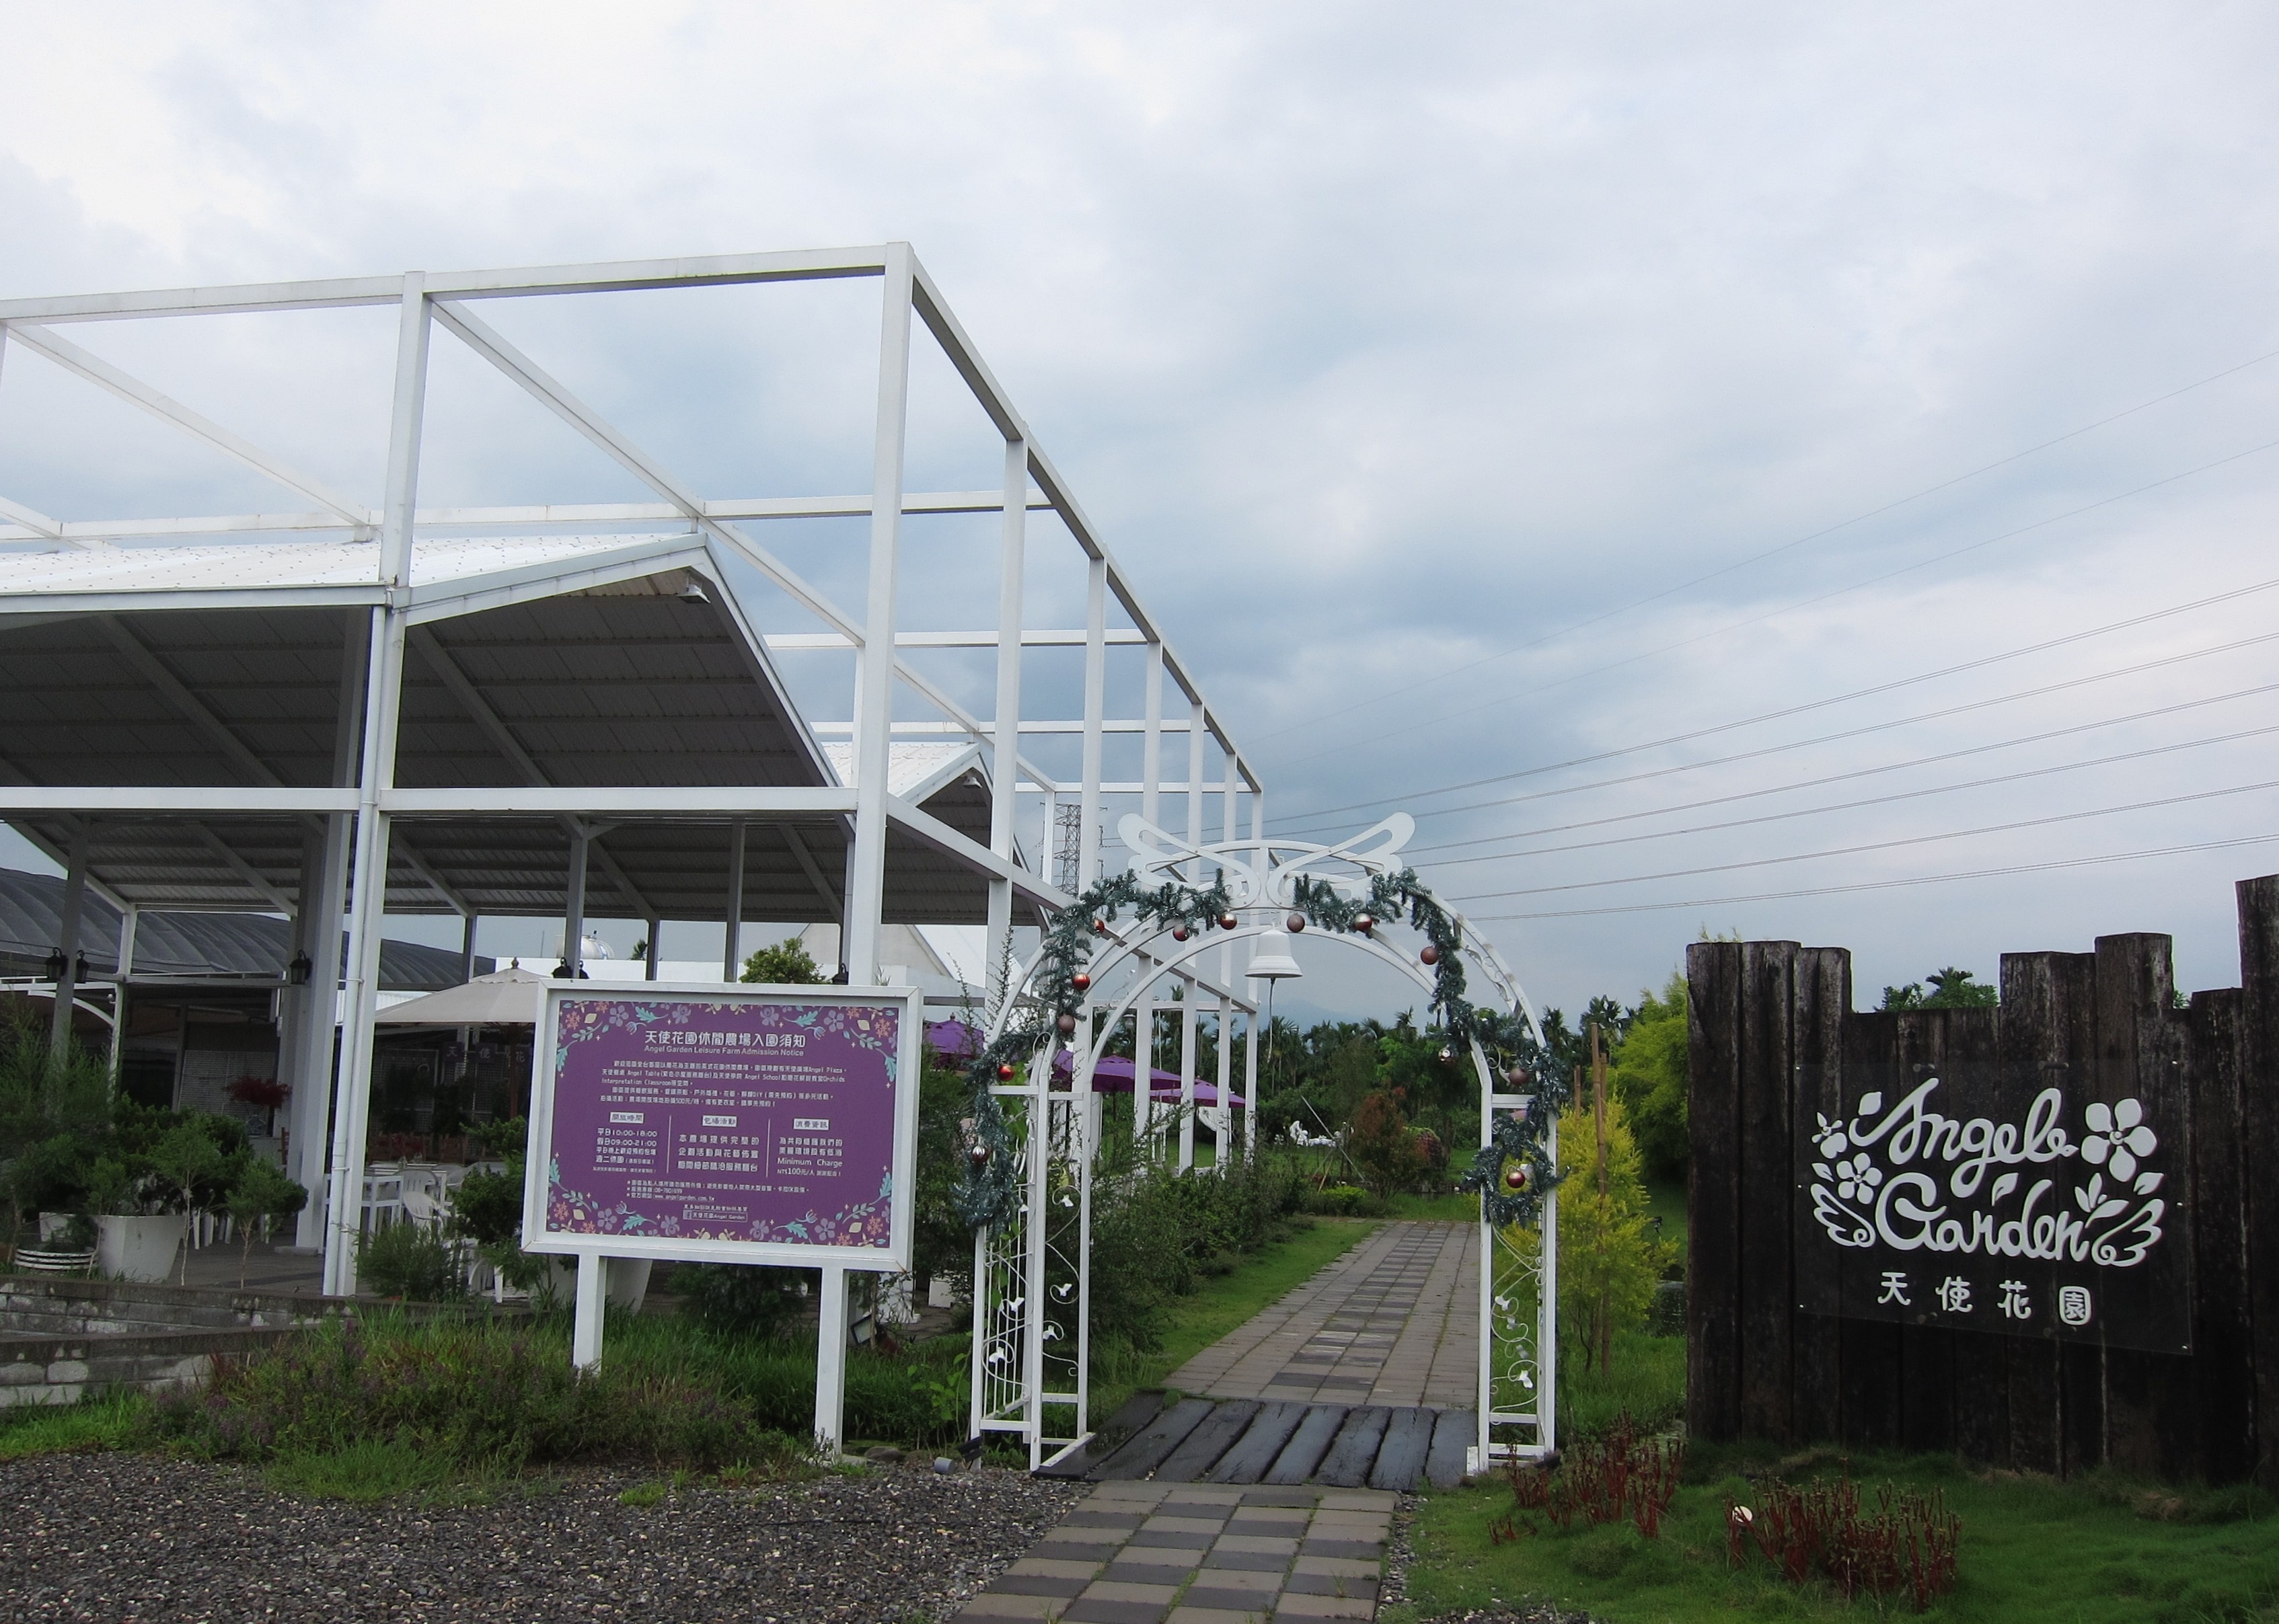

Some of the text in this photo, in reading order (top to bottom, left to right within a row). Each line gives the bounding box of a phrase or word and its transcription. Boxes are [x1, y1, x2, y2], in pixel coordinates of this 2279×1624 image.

[644, 1030, 805, 1048] 天使花園休閒農場入園須知
[644, 1045, 665, 1054] Angel
[611, 1113, 642, 1121] 開放時間
[704, 1117, 735, 1125] 包場活動
[795, 1120, 827, 1128] 消費資訊
[778, 1157, 843, 1169] Minimum Charge
[1875, 1172, 2090, 1262] Garden
[1877, 1271, 2092, 1326] 天使花園
